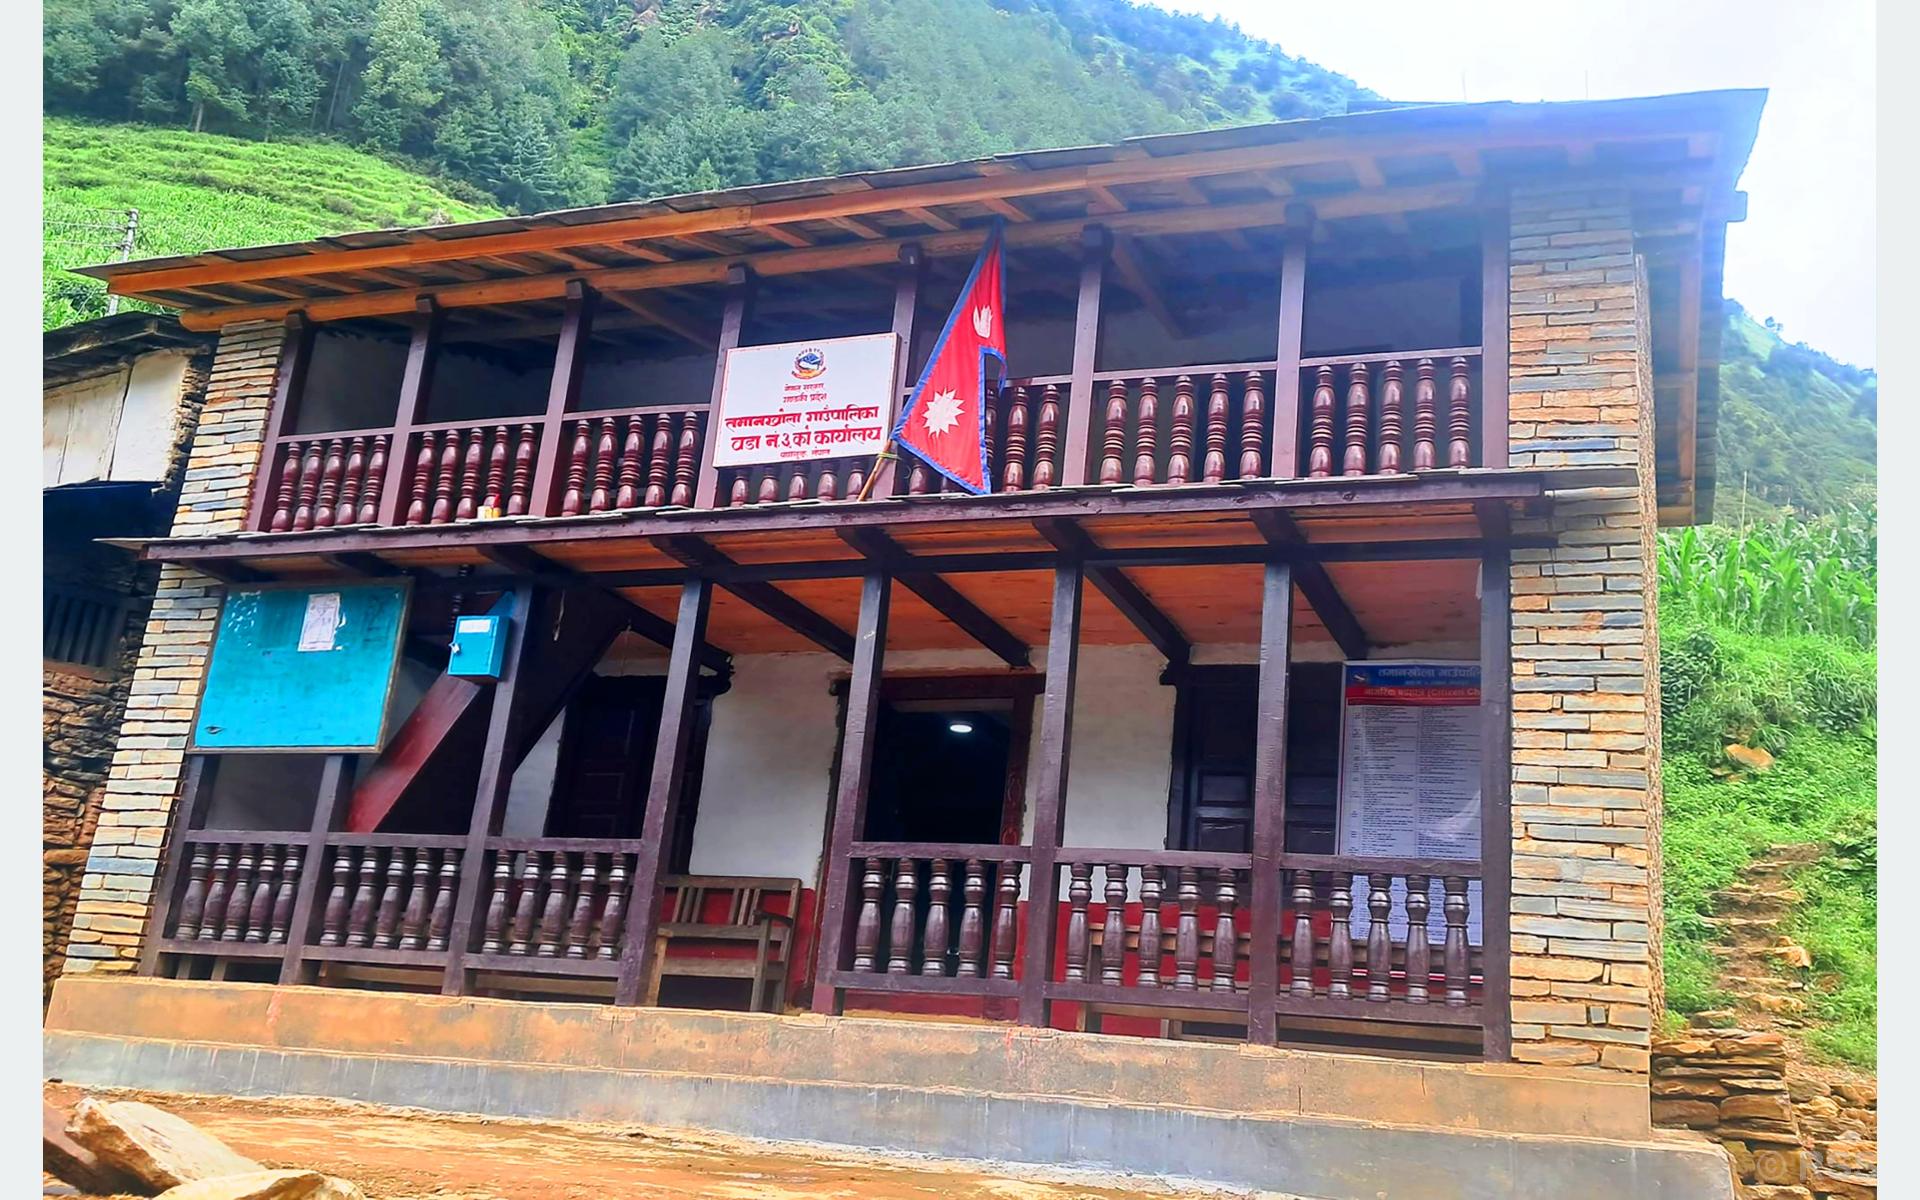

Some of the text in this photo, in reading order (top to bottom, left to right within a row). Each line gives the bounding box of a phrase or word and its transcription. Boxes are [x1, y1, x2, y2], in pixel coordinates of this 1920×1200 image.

[725, 408, 801, 431] तमानखोला
[731, 435, 761, 451] वडा
[814, 424, 883, 445] कार्यालय
